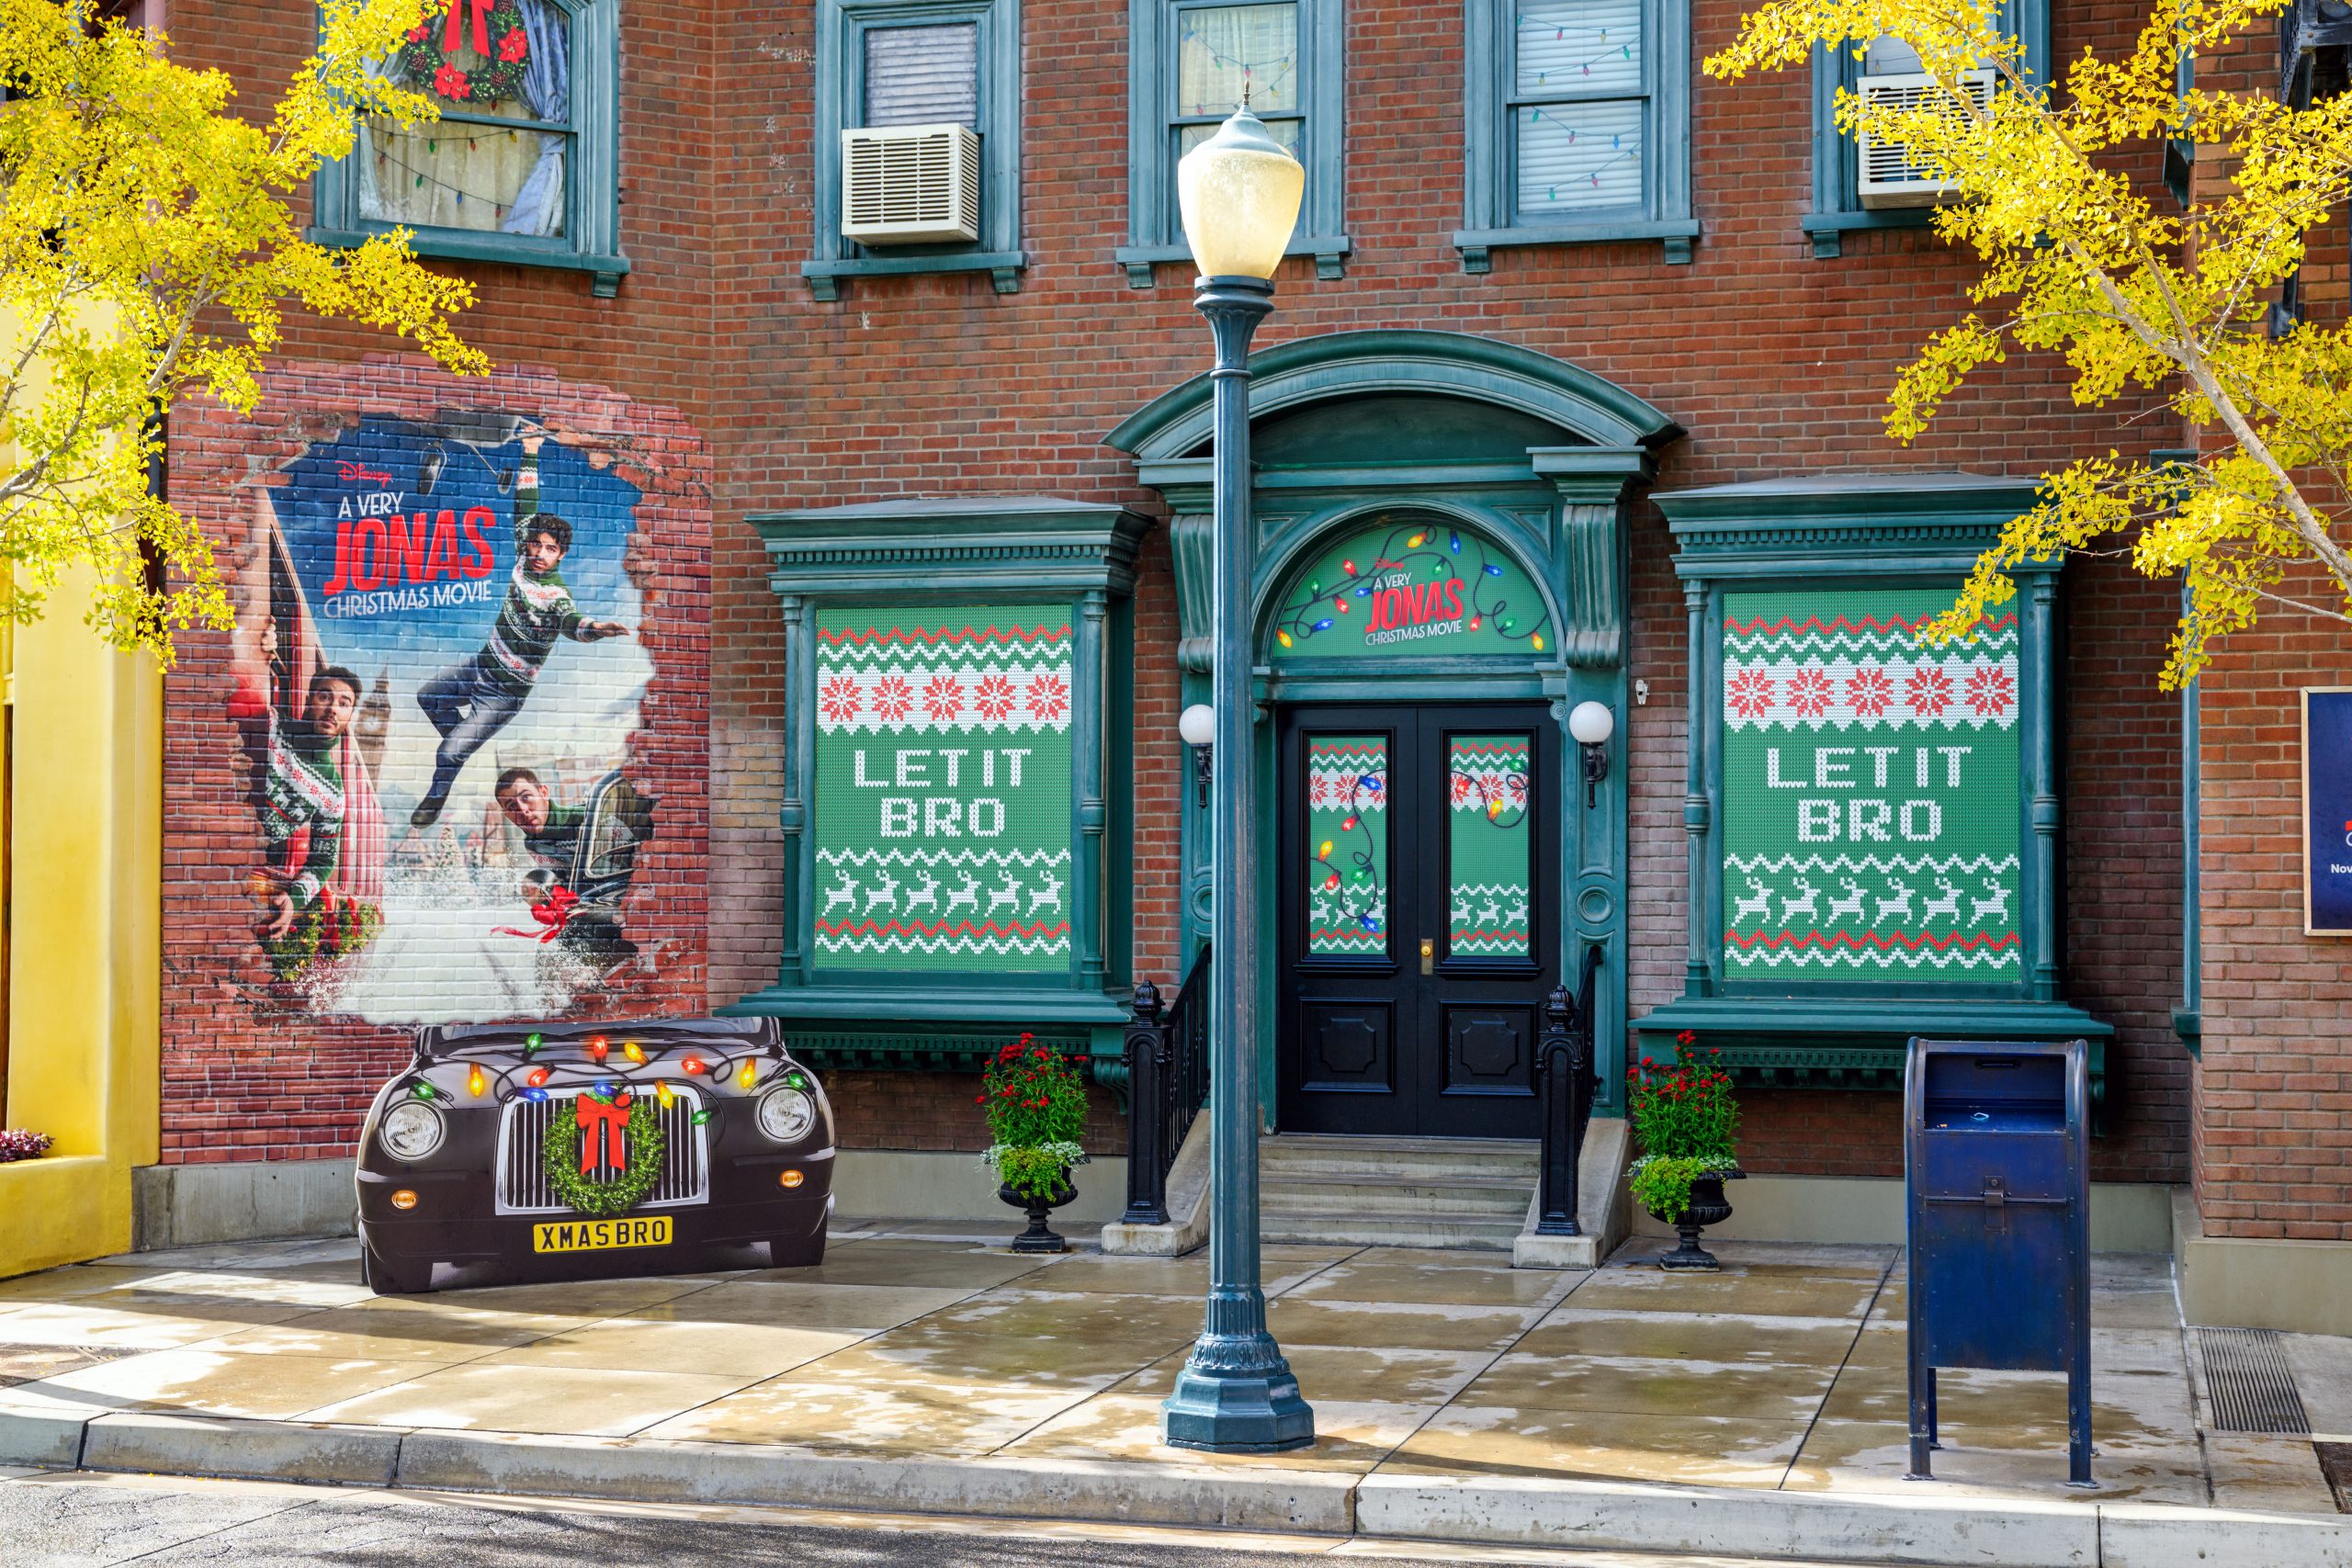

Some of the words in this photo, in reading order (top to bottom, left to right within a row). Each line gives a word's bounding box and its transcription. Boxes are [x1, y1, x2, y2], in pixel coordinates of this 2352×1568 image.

[335, 460, 392, 488] Disney
[338, 496, 353, 519] A
[356, 491, 403, 515] VERY
[323, 506, 496, 595] JONAS
[323, 588, 429, 619] CHRISTMAS
[433, 580, 492, 607] MOVIE
[1374, 577, 1383, 590] A
[1385, 572, 1411, 588] VERY
[1365, 578, 1464, 634] JONAS
[1365, 626, 1426, 646] CHRISTMAS
[1427, 619, 1463, 637] MOVIE
[854, 749, 969, 787] LET
[983, 749, 1032, 787] IT
[1767, 746, 1899, 788] LET
[1916, 746, 1973, 788] IT
[880, 797, 1005, 838] BRO
[1797, 799, 1942, 842] BRO
